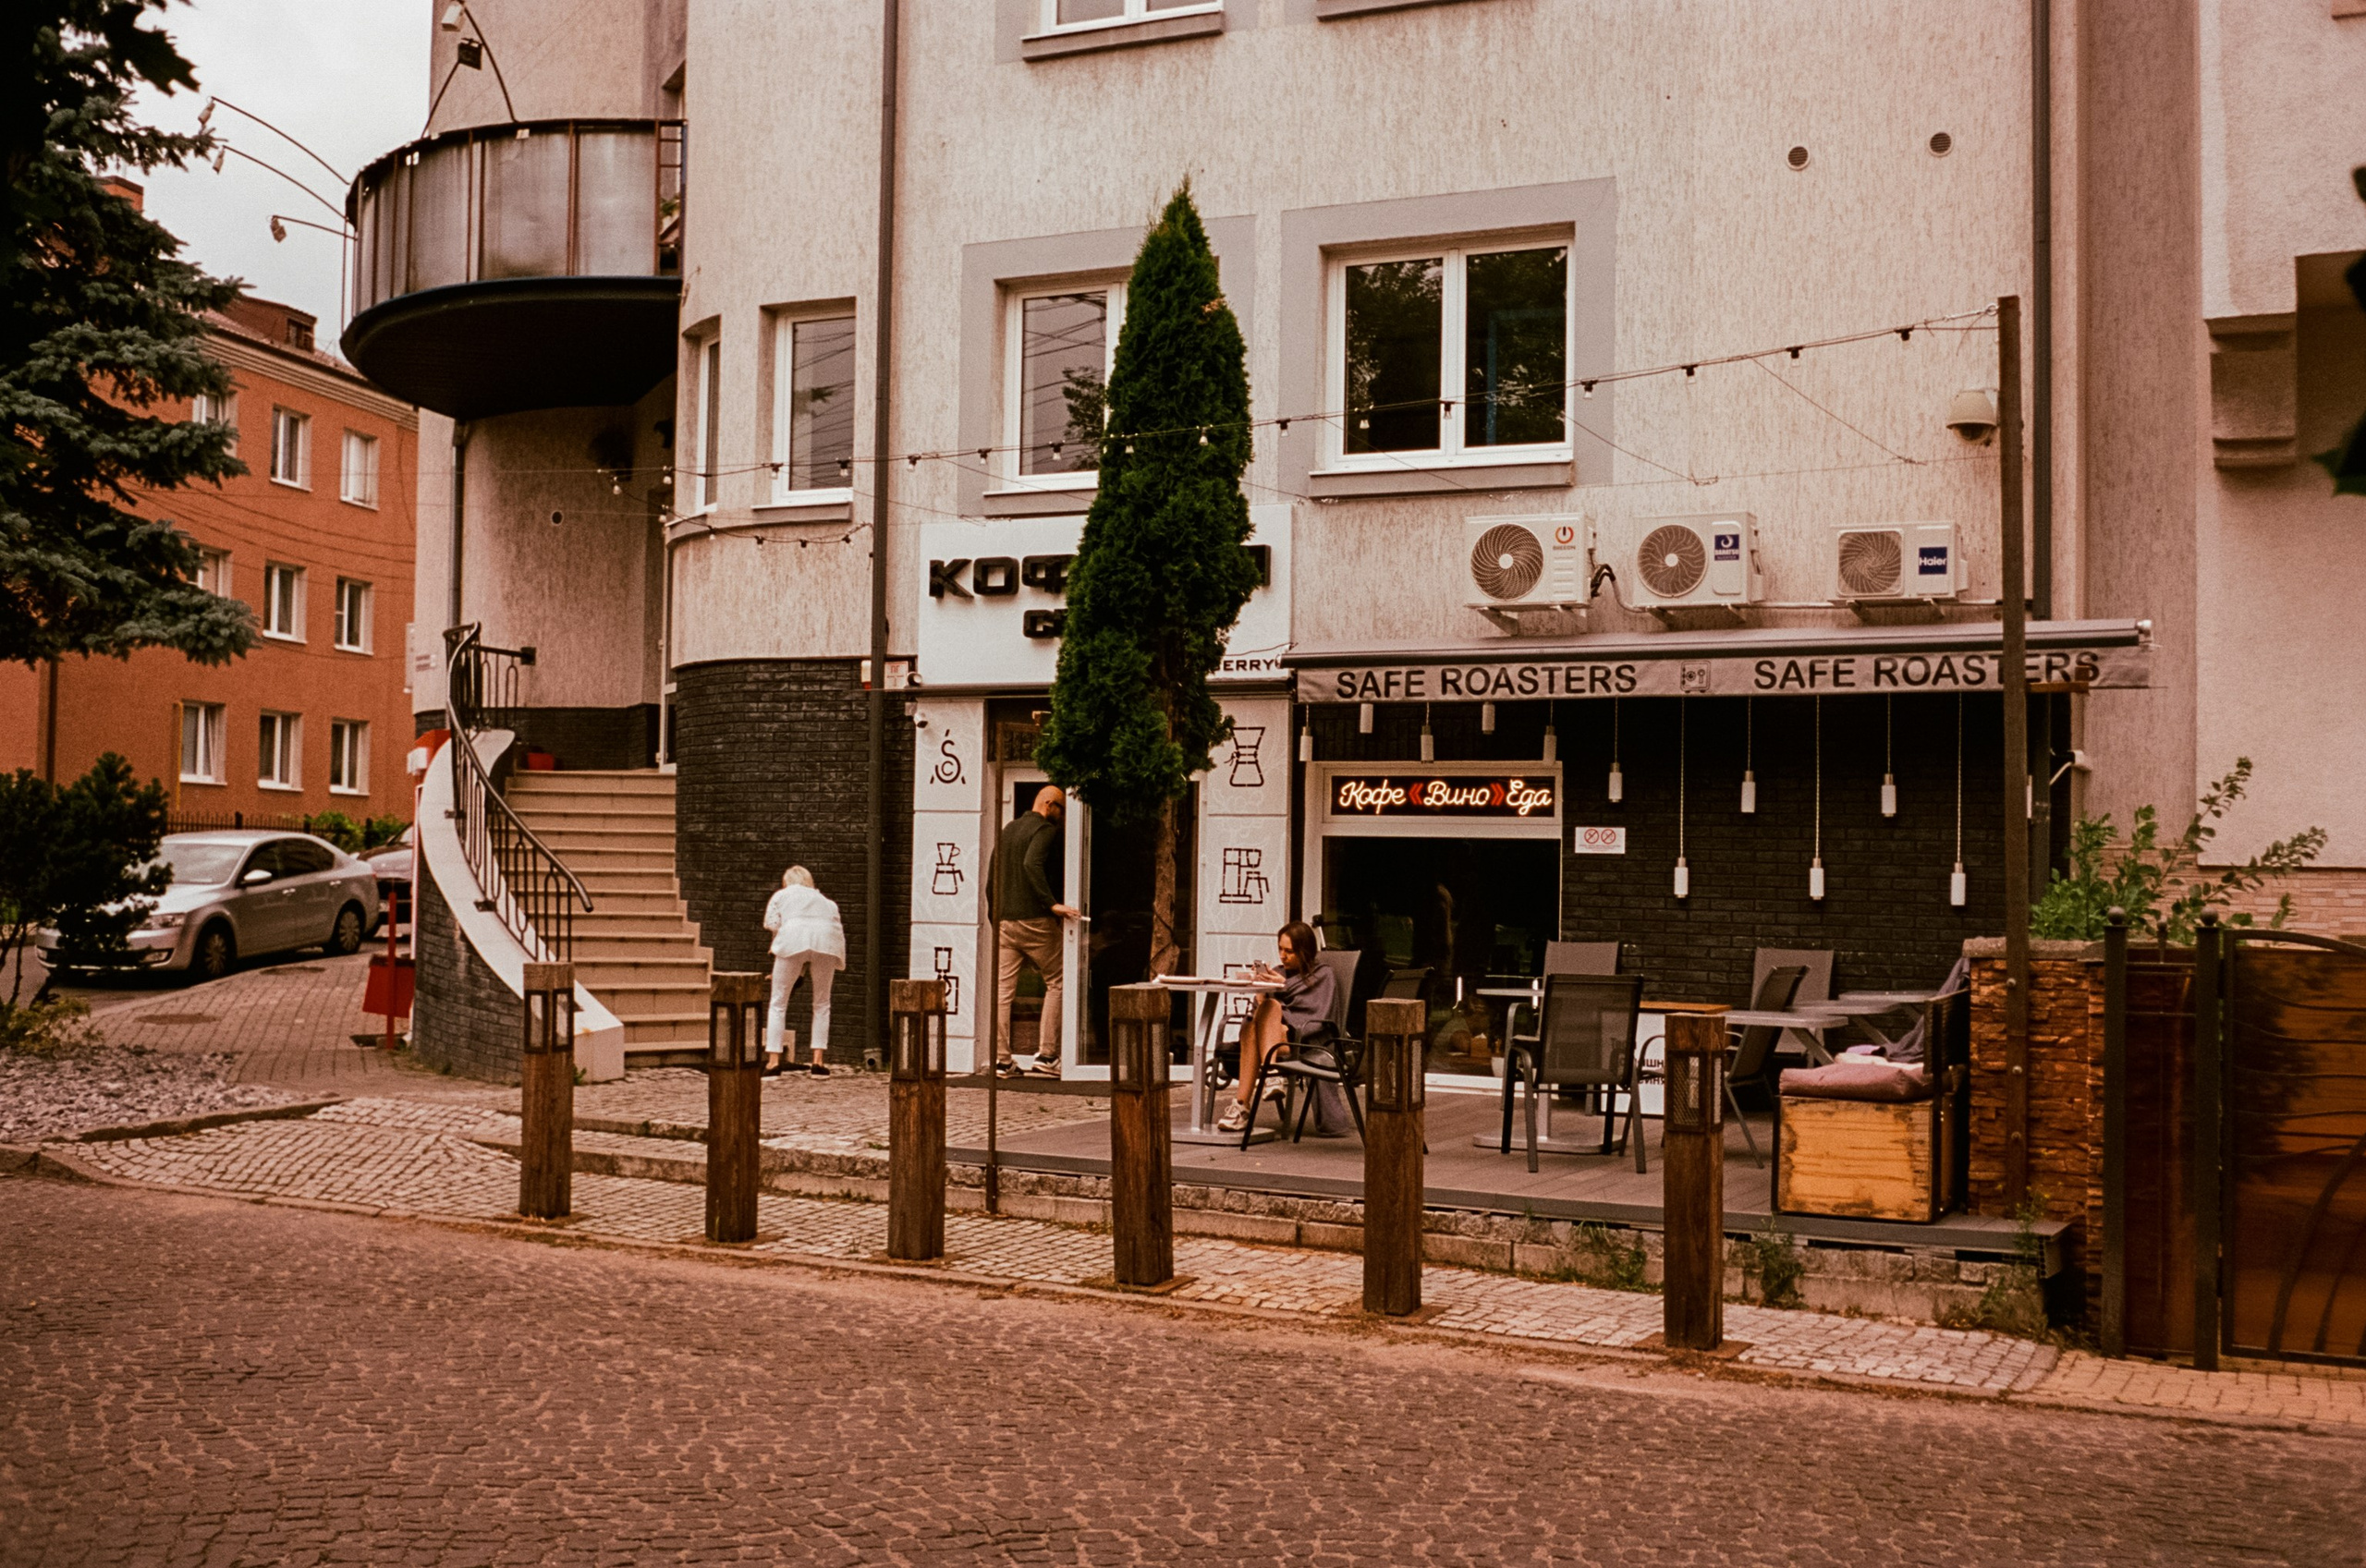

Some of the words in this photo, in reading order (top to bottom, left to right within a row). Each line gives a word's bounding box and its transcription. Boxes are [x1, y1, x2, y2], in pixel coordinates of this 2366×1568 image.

[1919, 556, 1947, 566] Haier
[1336, 670, 1425, 699] SAFE
[1441, 664, 1637, 696] ROASTERS
[1754, 658, 1856, 689] SAFE
[1339, 779, 1407, 815] Кофе
[1506, 779, 1553, 816] Еда
